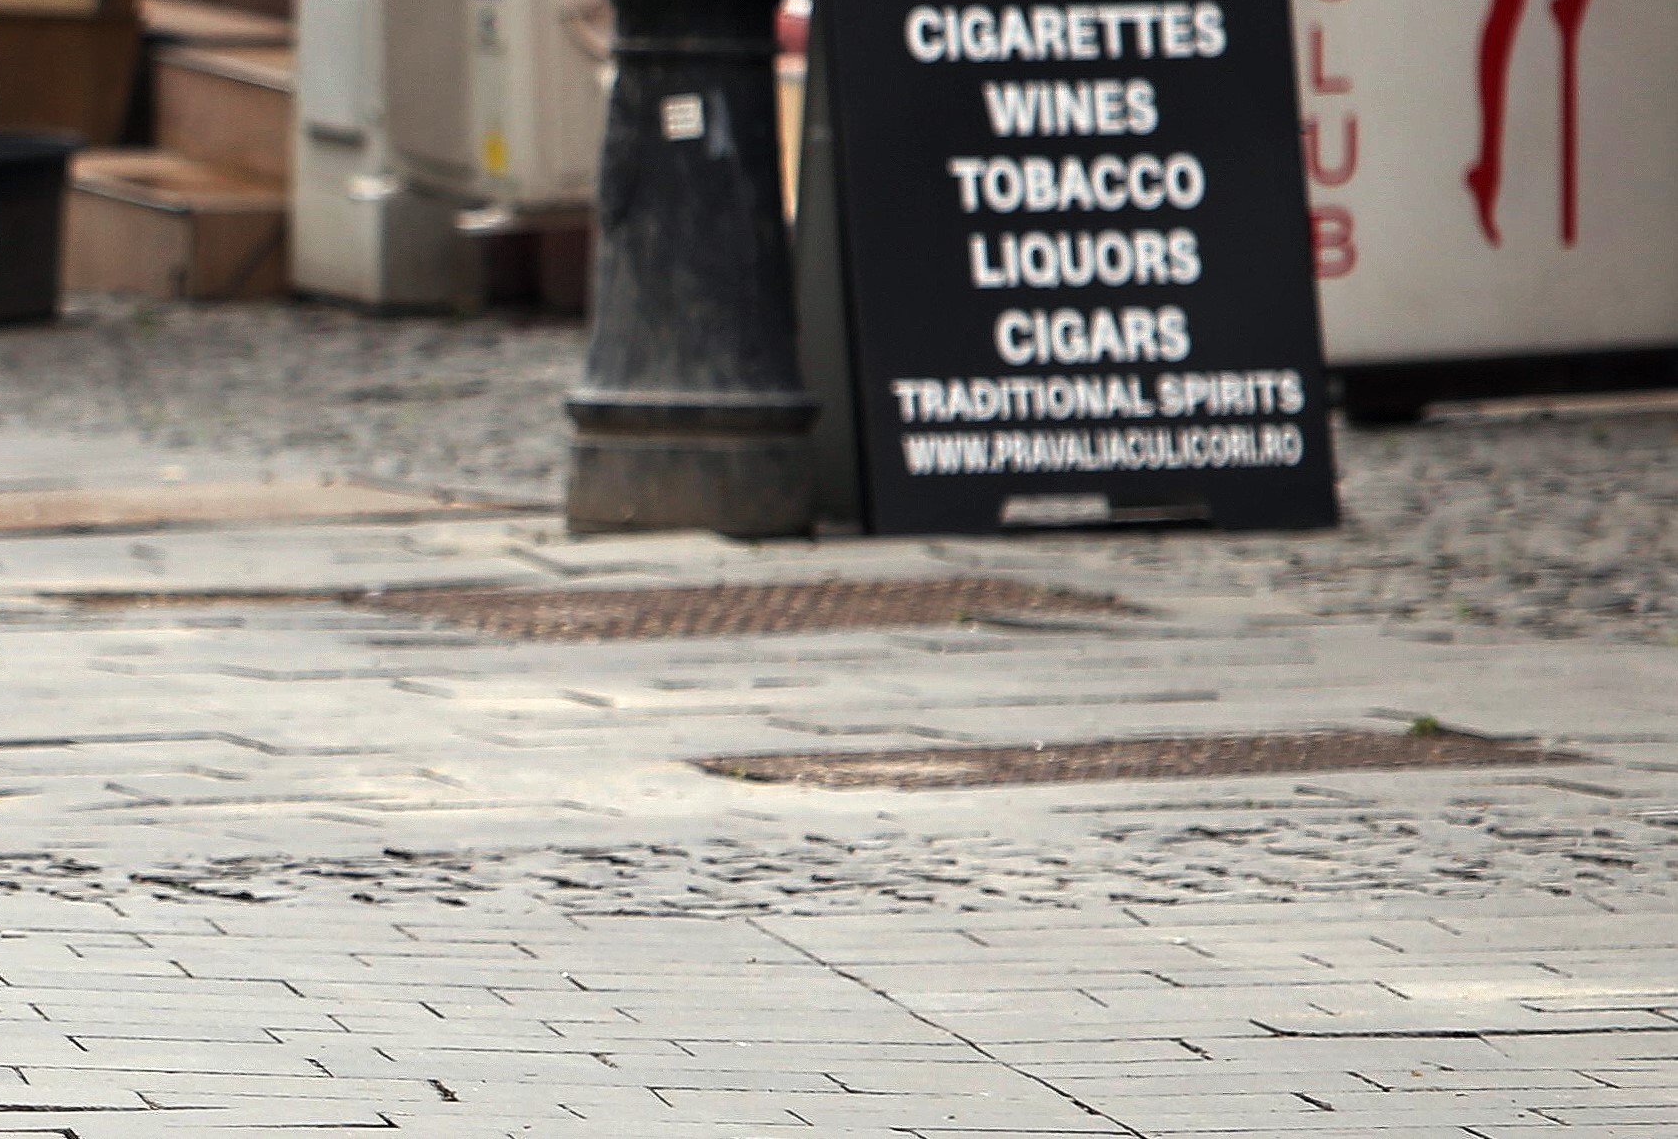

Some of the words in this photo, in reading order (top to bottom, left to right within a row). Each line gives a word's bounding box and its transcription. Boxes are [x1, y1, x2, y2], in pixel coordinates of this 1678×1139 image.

[906, 0, 1226, 61] CIGARETTES
[984, 79, 1158, 137] WINES
[949, 153, 1205, 212] TOBACCO
[968, 229, 1201, 288] LIQUORS
[994, 307, 1190, 364] CIGARS
[891, 374, 1154, 423] TRADITIONAL
[1156, 369, 1304, 416] SPIRITS
